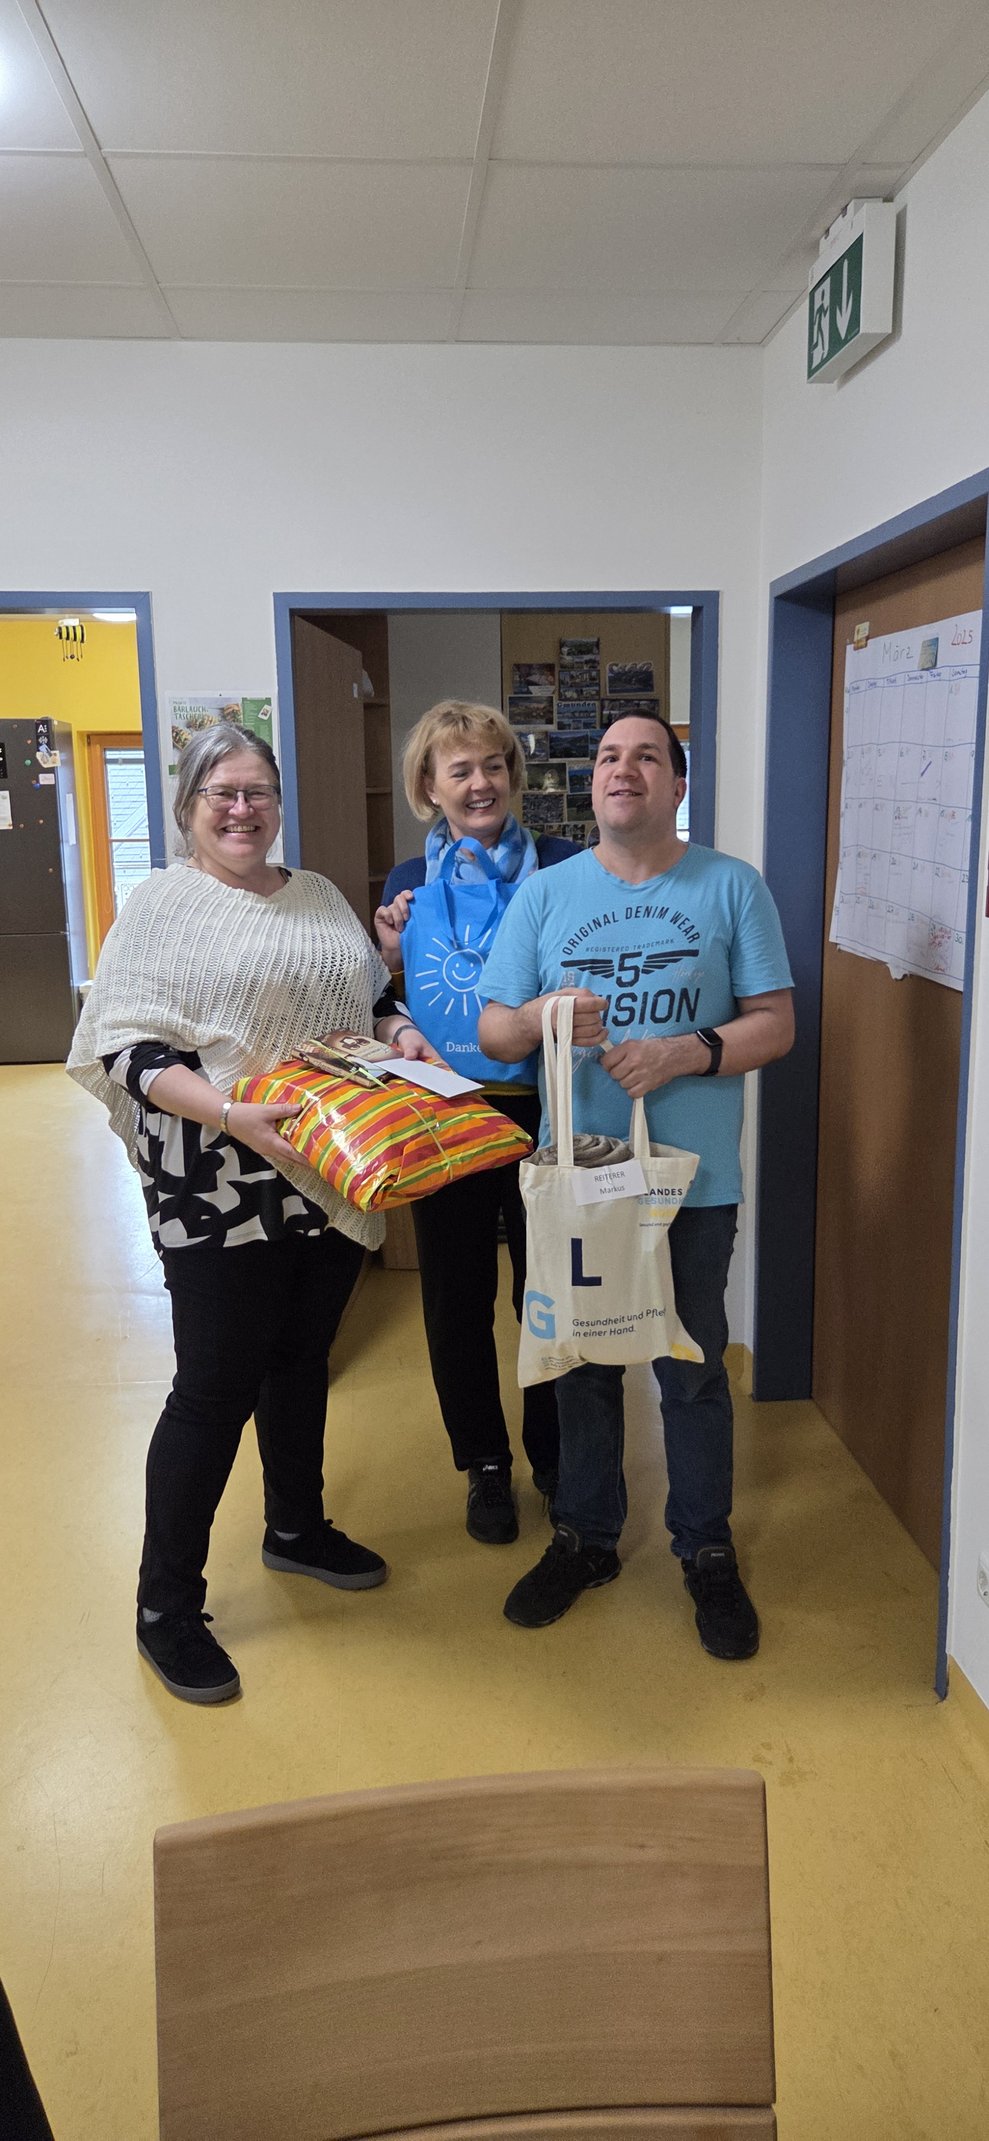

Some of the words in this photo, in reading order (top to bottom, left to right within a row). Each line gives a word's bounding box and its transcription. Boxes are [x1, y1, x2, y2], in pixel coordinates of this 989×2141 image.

[951, 624, 973, 646] 2025
[562, 911, 619, 955] ORIGINAL
[625, 905, 670, 920] DENIM
[670, 910, 700, 944] WEAR
[633, 939, 675, 951] TRADEMARK
[615, 951, 643, 988] 5
[597, 987, 700, 1027] ISION
[594, 1170, 626, 1182] REITERER
[600, 1184, 625, 1195] Markus
[644, 1188, 683, 1196] ANDES
[571, 1237, 602, 1287] L
[525, 1290, 556, 1340] G
[572, 1316, 626, 1328] Gesundheit
[627, 1311, 644, 1322] und
[572, 1329, 581, 1338] in
[583, 1329, 607, 1338] einer
[609, 1325, 637, 1337] Hand.
